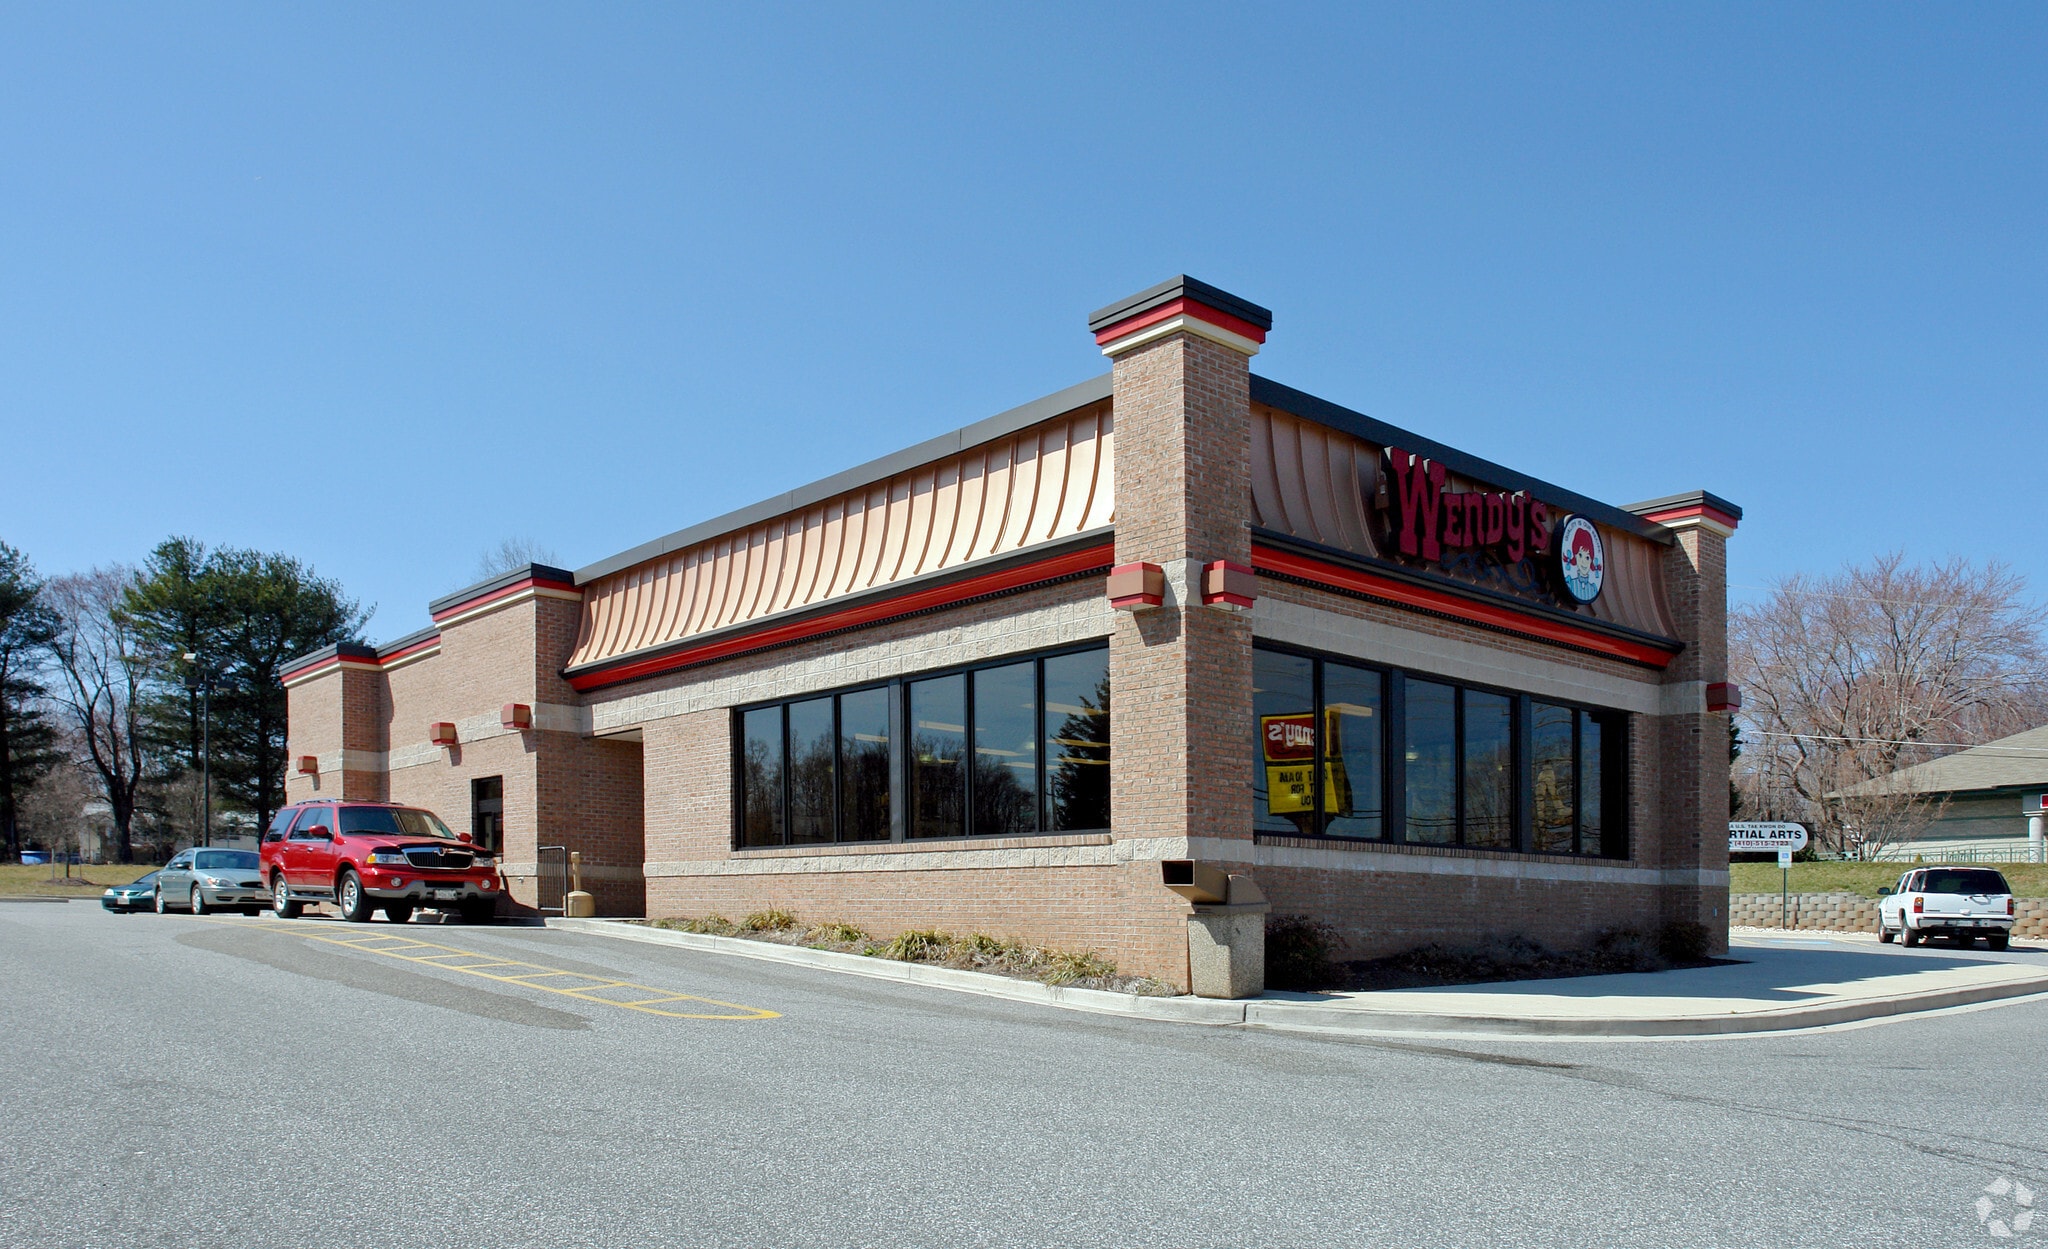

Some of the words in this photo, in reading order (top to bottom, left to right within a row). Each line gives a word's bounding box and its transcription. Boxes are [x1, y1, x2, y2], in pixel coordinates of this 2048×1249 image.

[1391, 447, 1548, 562] Wendy's
[1729, 830, 1765, 839] RTIAL
[1769, 830, 1802, 839] ARTS
